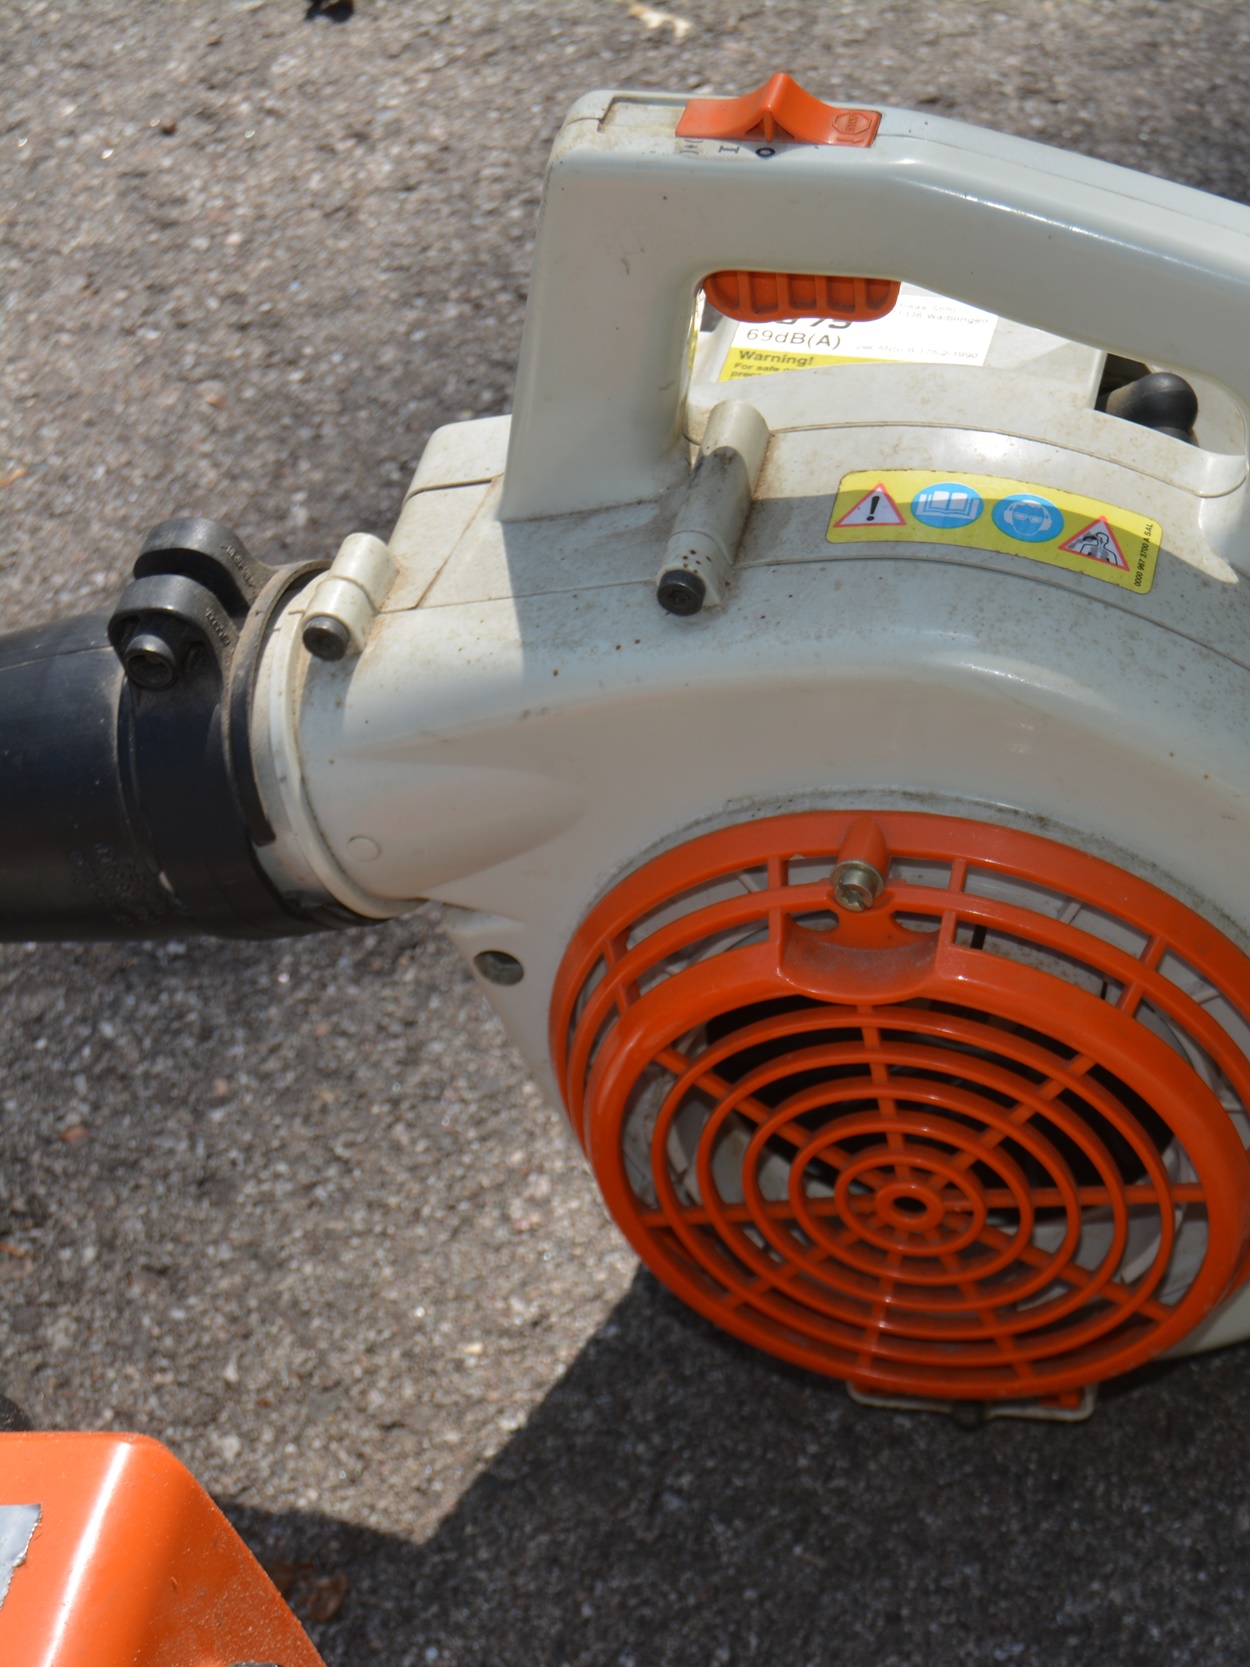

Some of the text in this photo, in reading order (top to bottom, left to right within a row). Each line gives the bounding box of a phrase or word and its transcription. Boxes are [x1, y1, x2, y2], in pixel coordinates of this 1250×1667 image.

[746, 328, 841, 350] 69dB(A)
[739, 350, 814, 367] Warning!
[734, 362, 753, 370] For
[756, 364, 780, 372] safe
[1144, 523, 1153, 536] SAL
